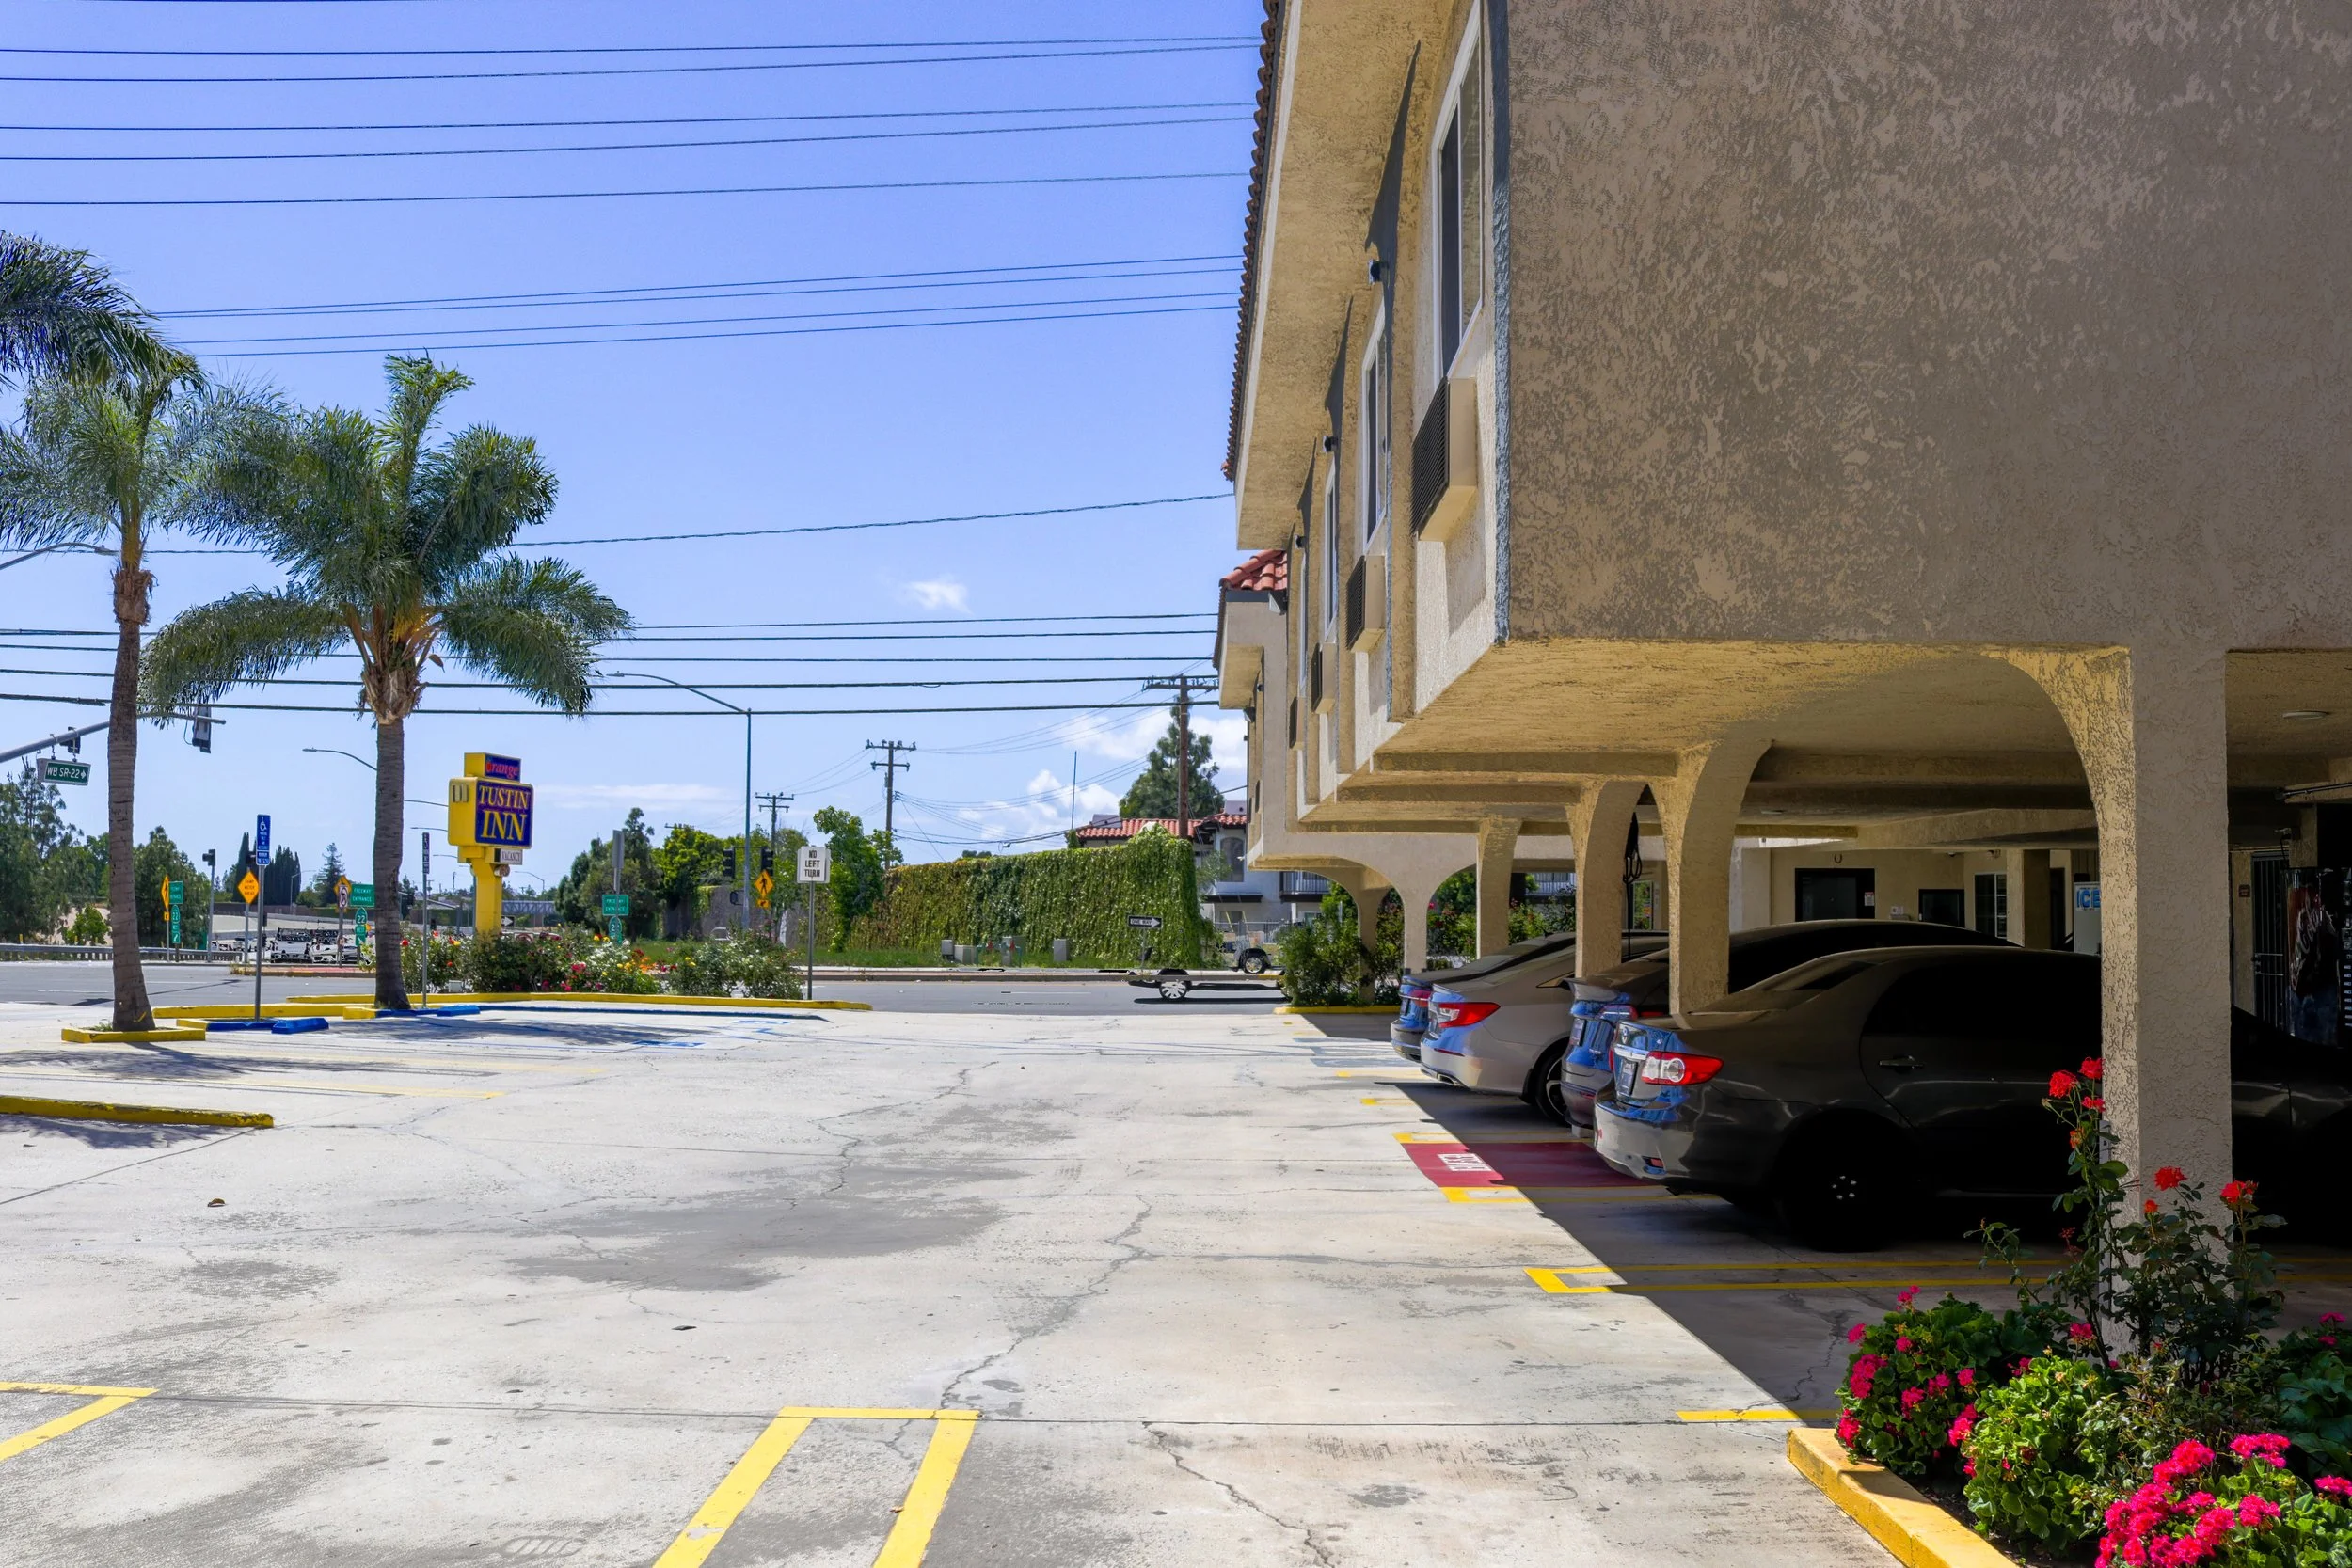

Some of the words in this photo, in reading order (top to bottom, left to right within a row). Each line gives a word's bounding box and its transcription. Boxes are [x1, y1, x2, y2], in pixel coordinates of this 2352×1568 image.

[48, 767, 58, 777] WB
[58, 767, 81, 779] SR-22
[486, 760, 519, 779] Orange
[478, 784, 531, 810] TUSTIN
[480, 809, 528, 842] INN
[2076, 889, 2101, 908] ICE
[357, 915, 365, 924] 22
